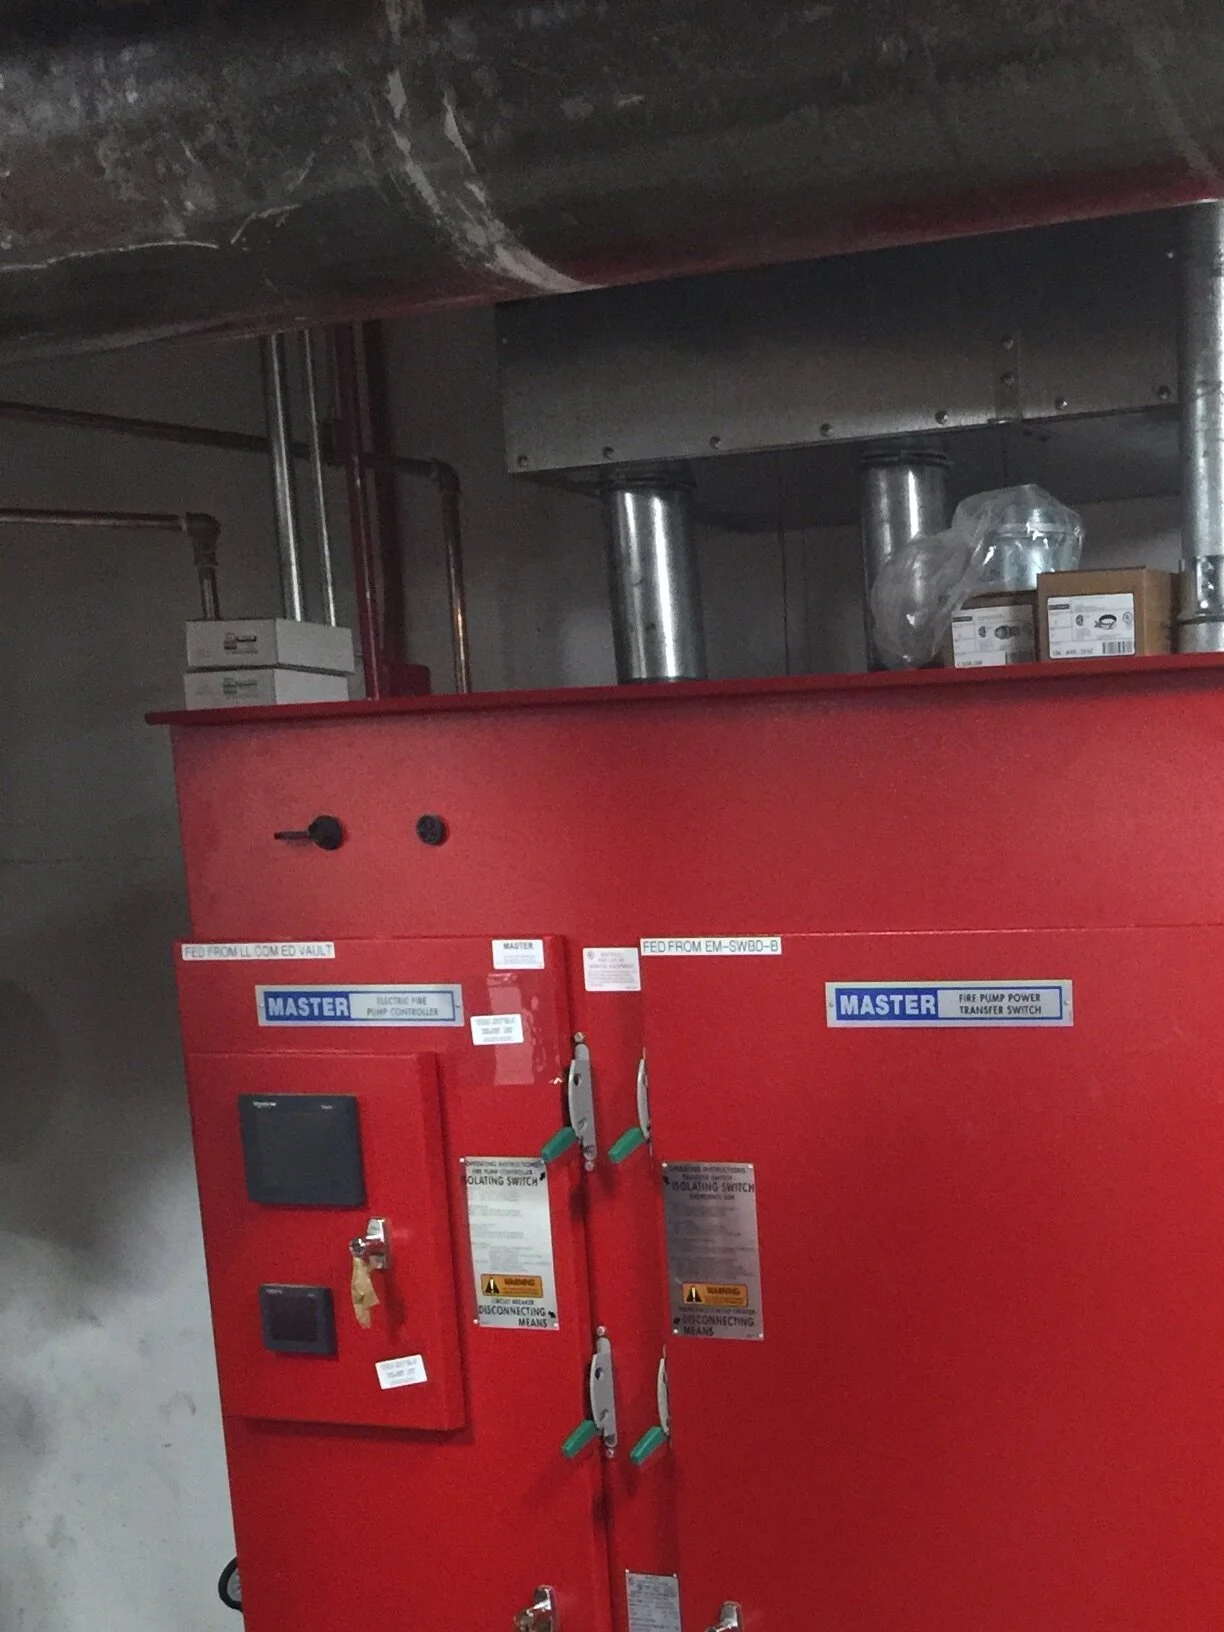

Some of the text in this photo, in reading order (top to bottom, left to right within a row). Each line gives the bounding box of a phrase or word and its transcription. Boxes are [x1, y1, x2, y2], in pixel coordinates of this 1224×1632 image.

[185, 947, 205, 958] FED
[207, 946, 238, 958] FROM
[299, 945, 332, 956] VAULT
[643, 940, 666, 953] FED
[668, 940, 701, 953] FROM
[376, 996, 427, 1006] ELECTRIC FIRE
[959, 993, 1041, 1003] FIRE PUMP POWER
[267, 996, 349, 1018] MASTER
[839, 994, 937, 1016] MASTER
[959, 1006, 1042, 1015] TRANSFER SWITCH
[366, 1007, 438, 1017] PUMP CONTROLLER
[507, 1176, 538, 1187] SWITCH
[671, 1181, 755, 1193] ISOLATING SWITCH
[478, 1304, 546, 1317] DISCONNECTING
[518, 1317, 548, 1328] MEANS
[682, 1314, 755, 1328] DISCONNECTING
[683, 1325, 714, 1337] MEANS
